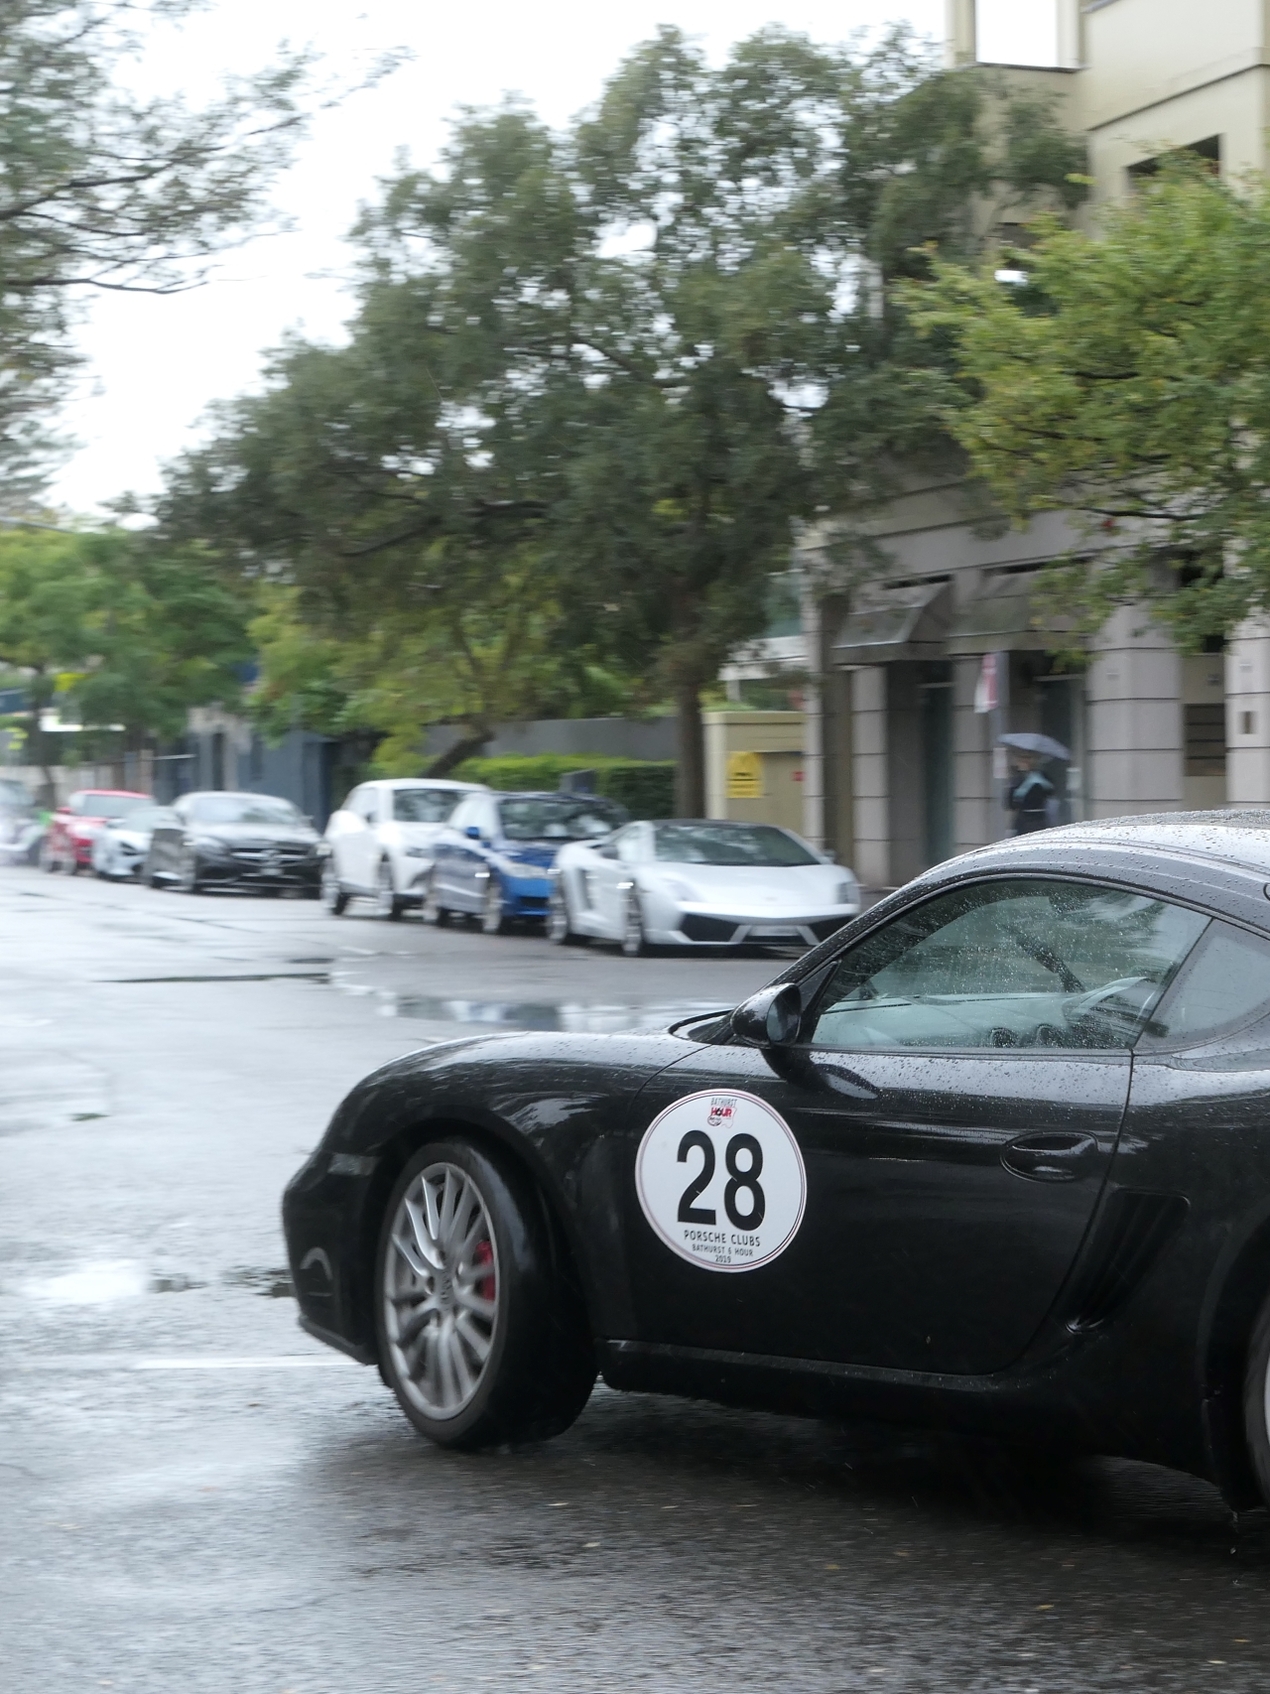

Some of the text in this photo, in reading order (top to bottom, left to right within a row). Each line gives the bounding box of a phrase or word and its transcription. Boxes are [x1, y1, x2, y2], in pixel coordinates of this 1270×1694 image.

[677, 1129, 766, 1231] 28
[683, 1229, 761, 1247] PORSCHE CLUBS
[692, 1243, 725, 1255] BATHURST
[734, 1247, 754, 1257] HOUR
[715, 1254, 732, 1263] 2019
